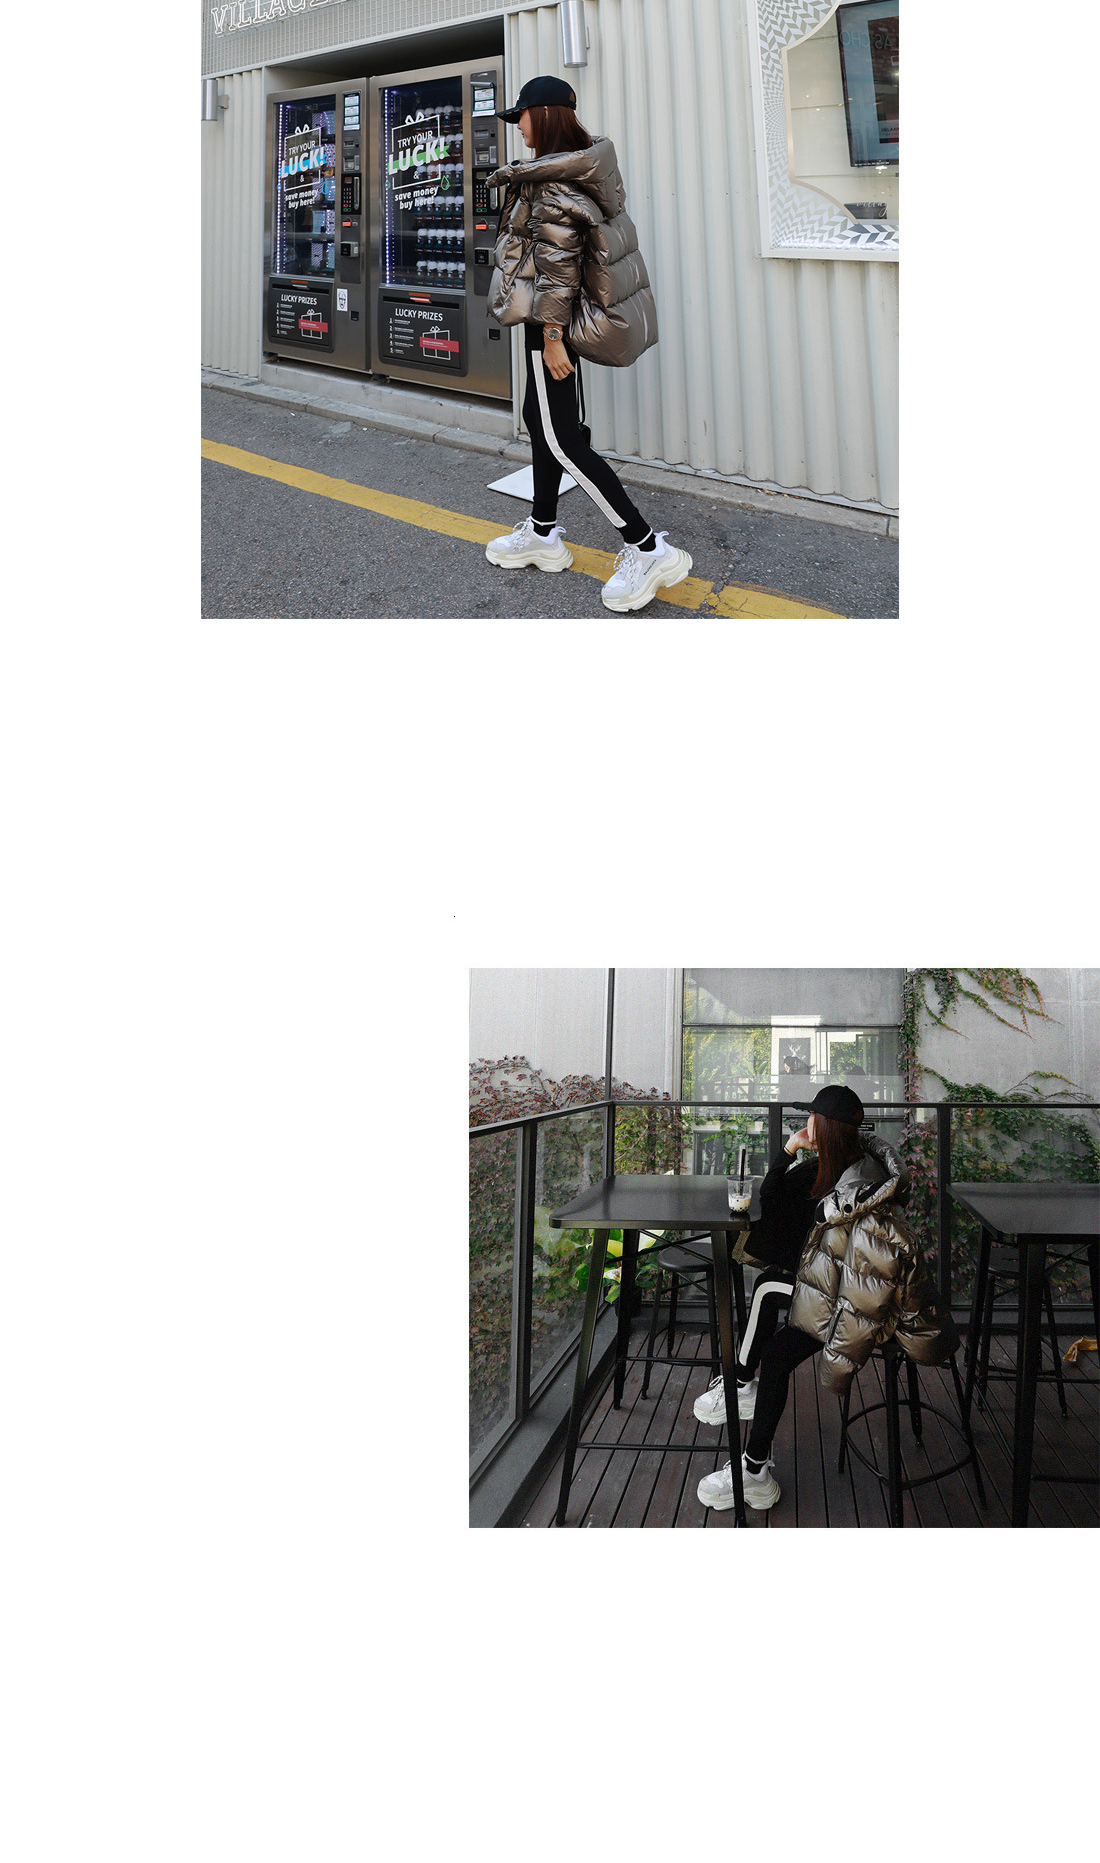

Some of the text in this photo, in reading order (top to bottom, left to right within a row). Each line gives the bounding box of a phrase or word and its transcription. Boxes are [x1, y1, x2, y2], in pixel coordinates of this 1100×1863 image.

[397, 130, 433, 148] TRY YOUR
[288, 140, 315, 155] TRY YOUR
[281, 146, 325, 178] LUCK!
[388, 137, 445, 175] LUCK!
[413, 171, 420, 179] &
[285, 192, 298, 201] save
[394, 186, 439, 201] save money
[288, 197, 315, 209] buy here!
[399, 196, 434, 210] buy here!
[280, 293, 317, 306] LUCKY PRIZES
[395, 308, 443, 322] LUCKY PRIZES
